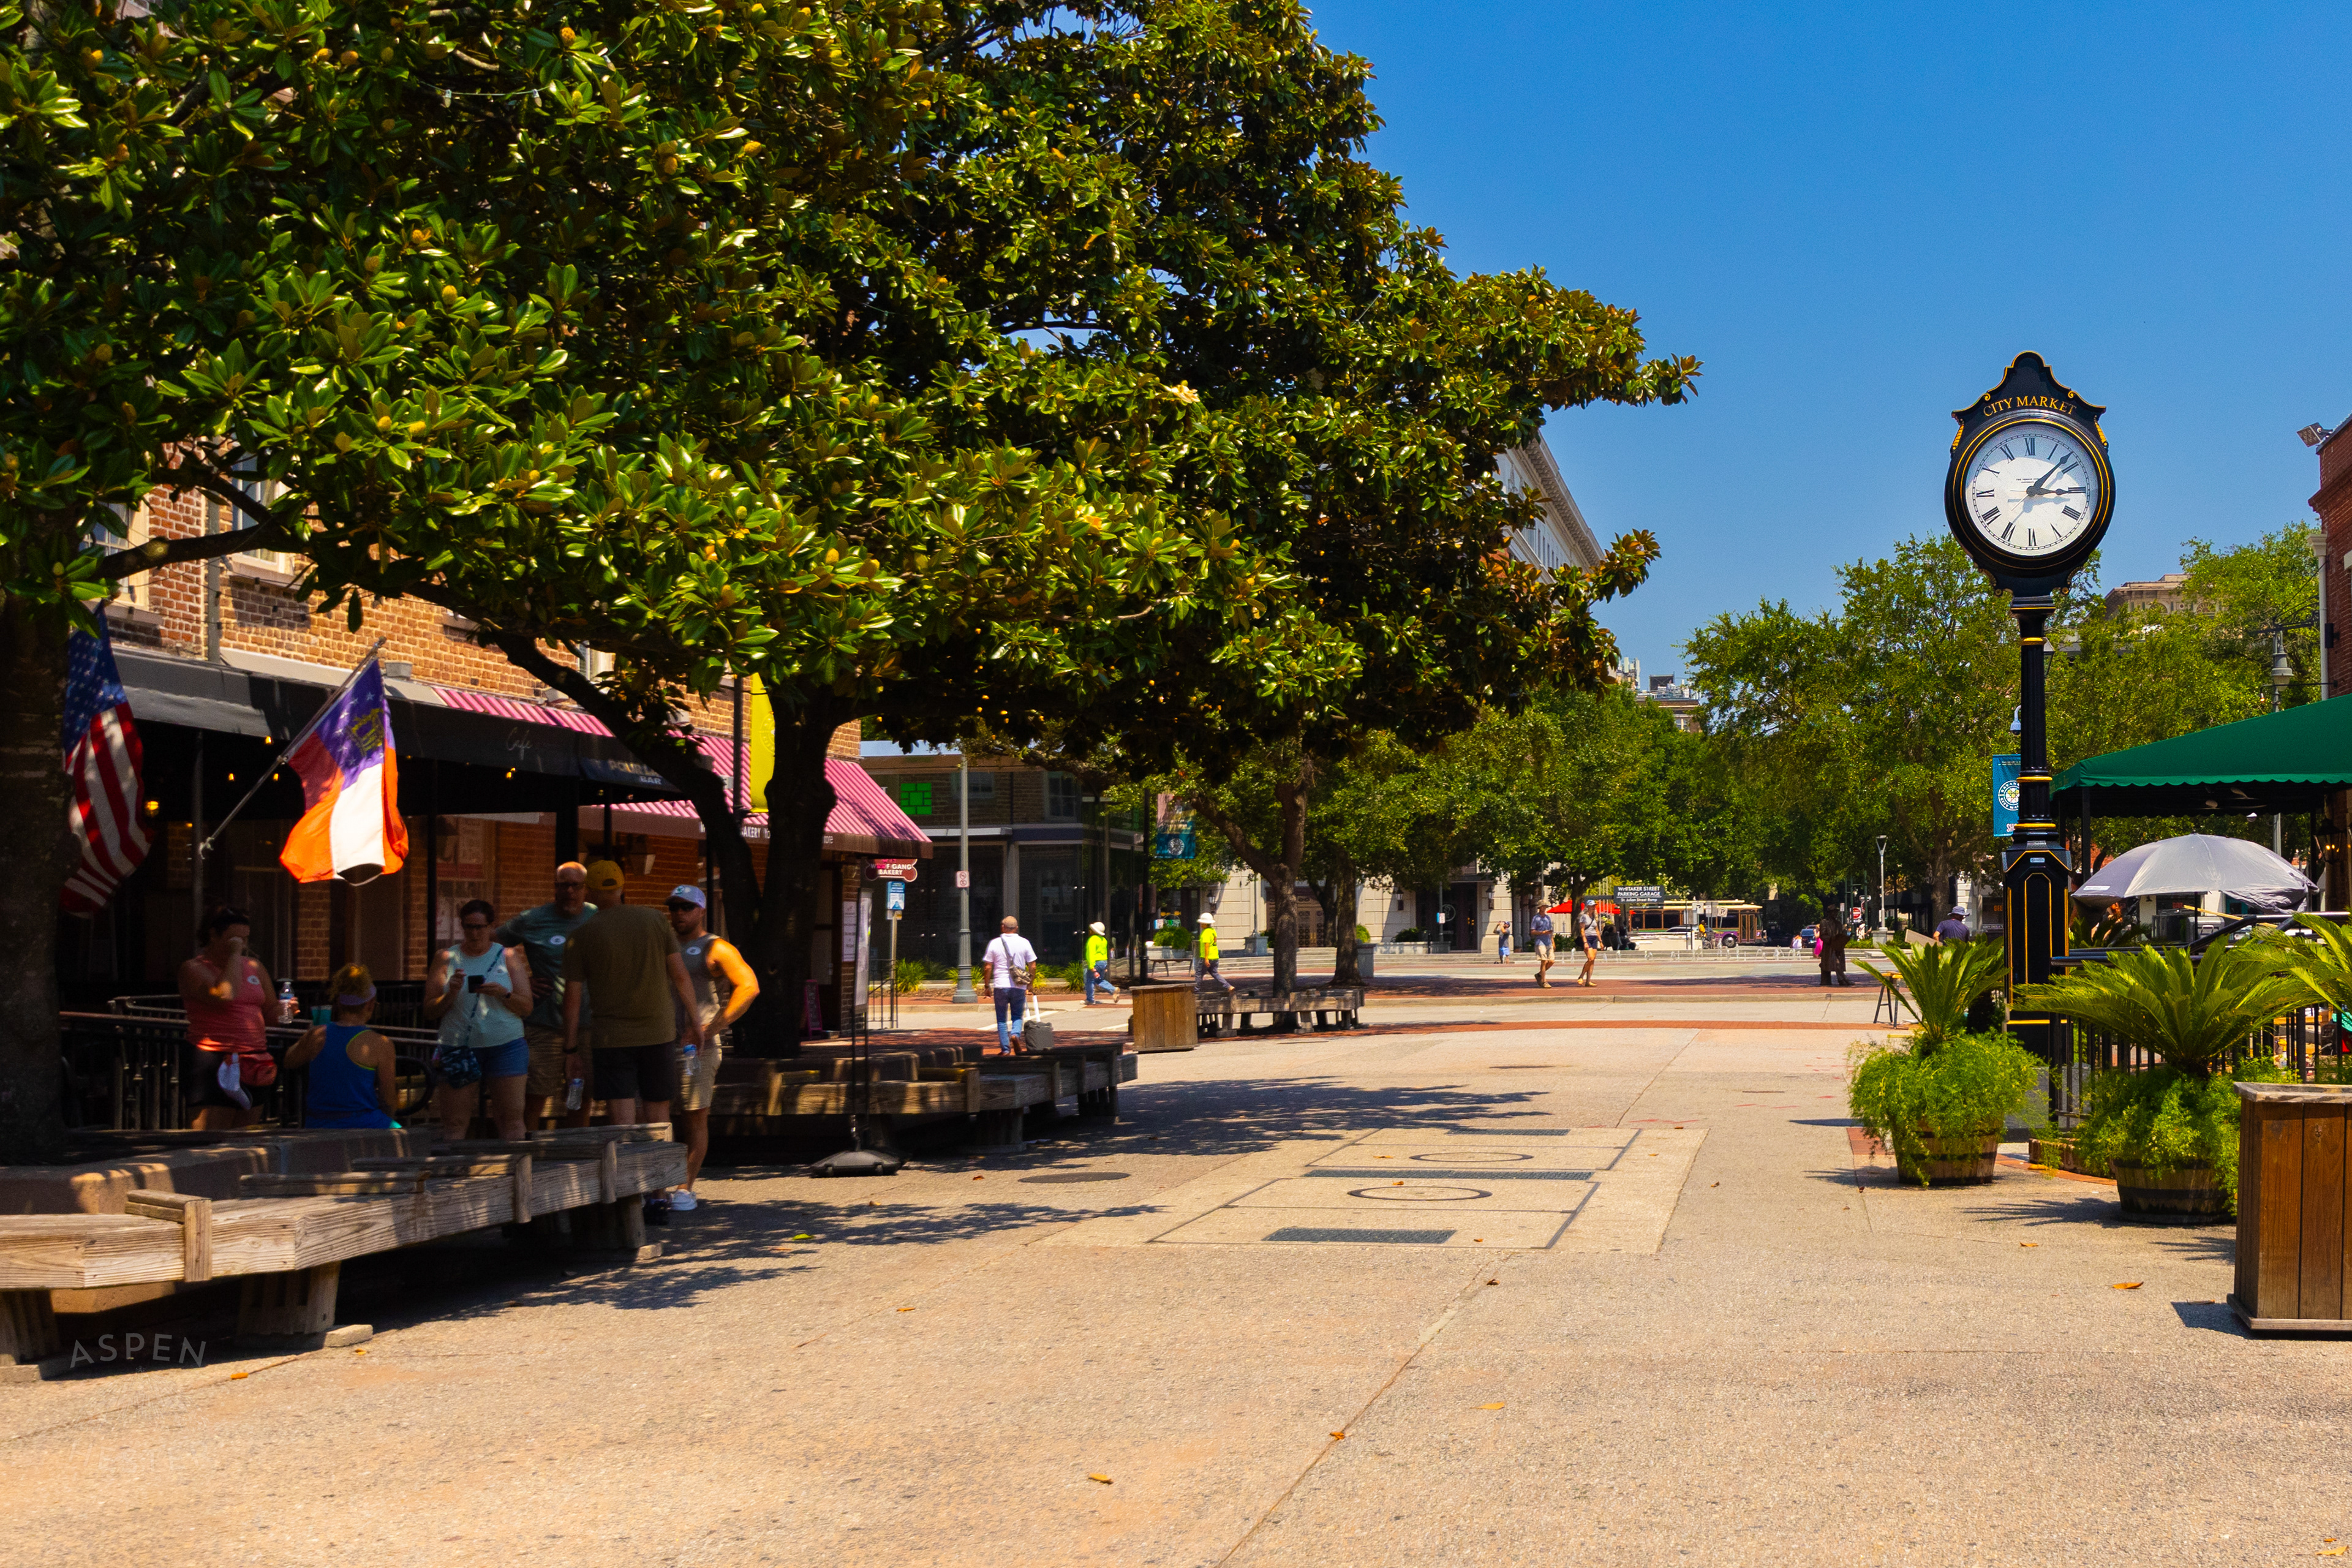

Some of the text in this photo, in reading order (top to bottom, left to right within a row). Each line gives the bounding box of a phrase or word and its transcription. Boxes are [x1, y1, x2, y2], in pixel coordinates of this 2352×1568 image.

[1983, 396, 2077, 416] CITY MARKET
[639, 775, 662, 785] BAR
[741, 826, 761, 838] AKERY
